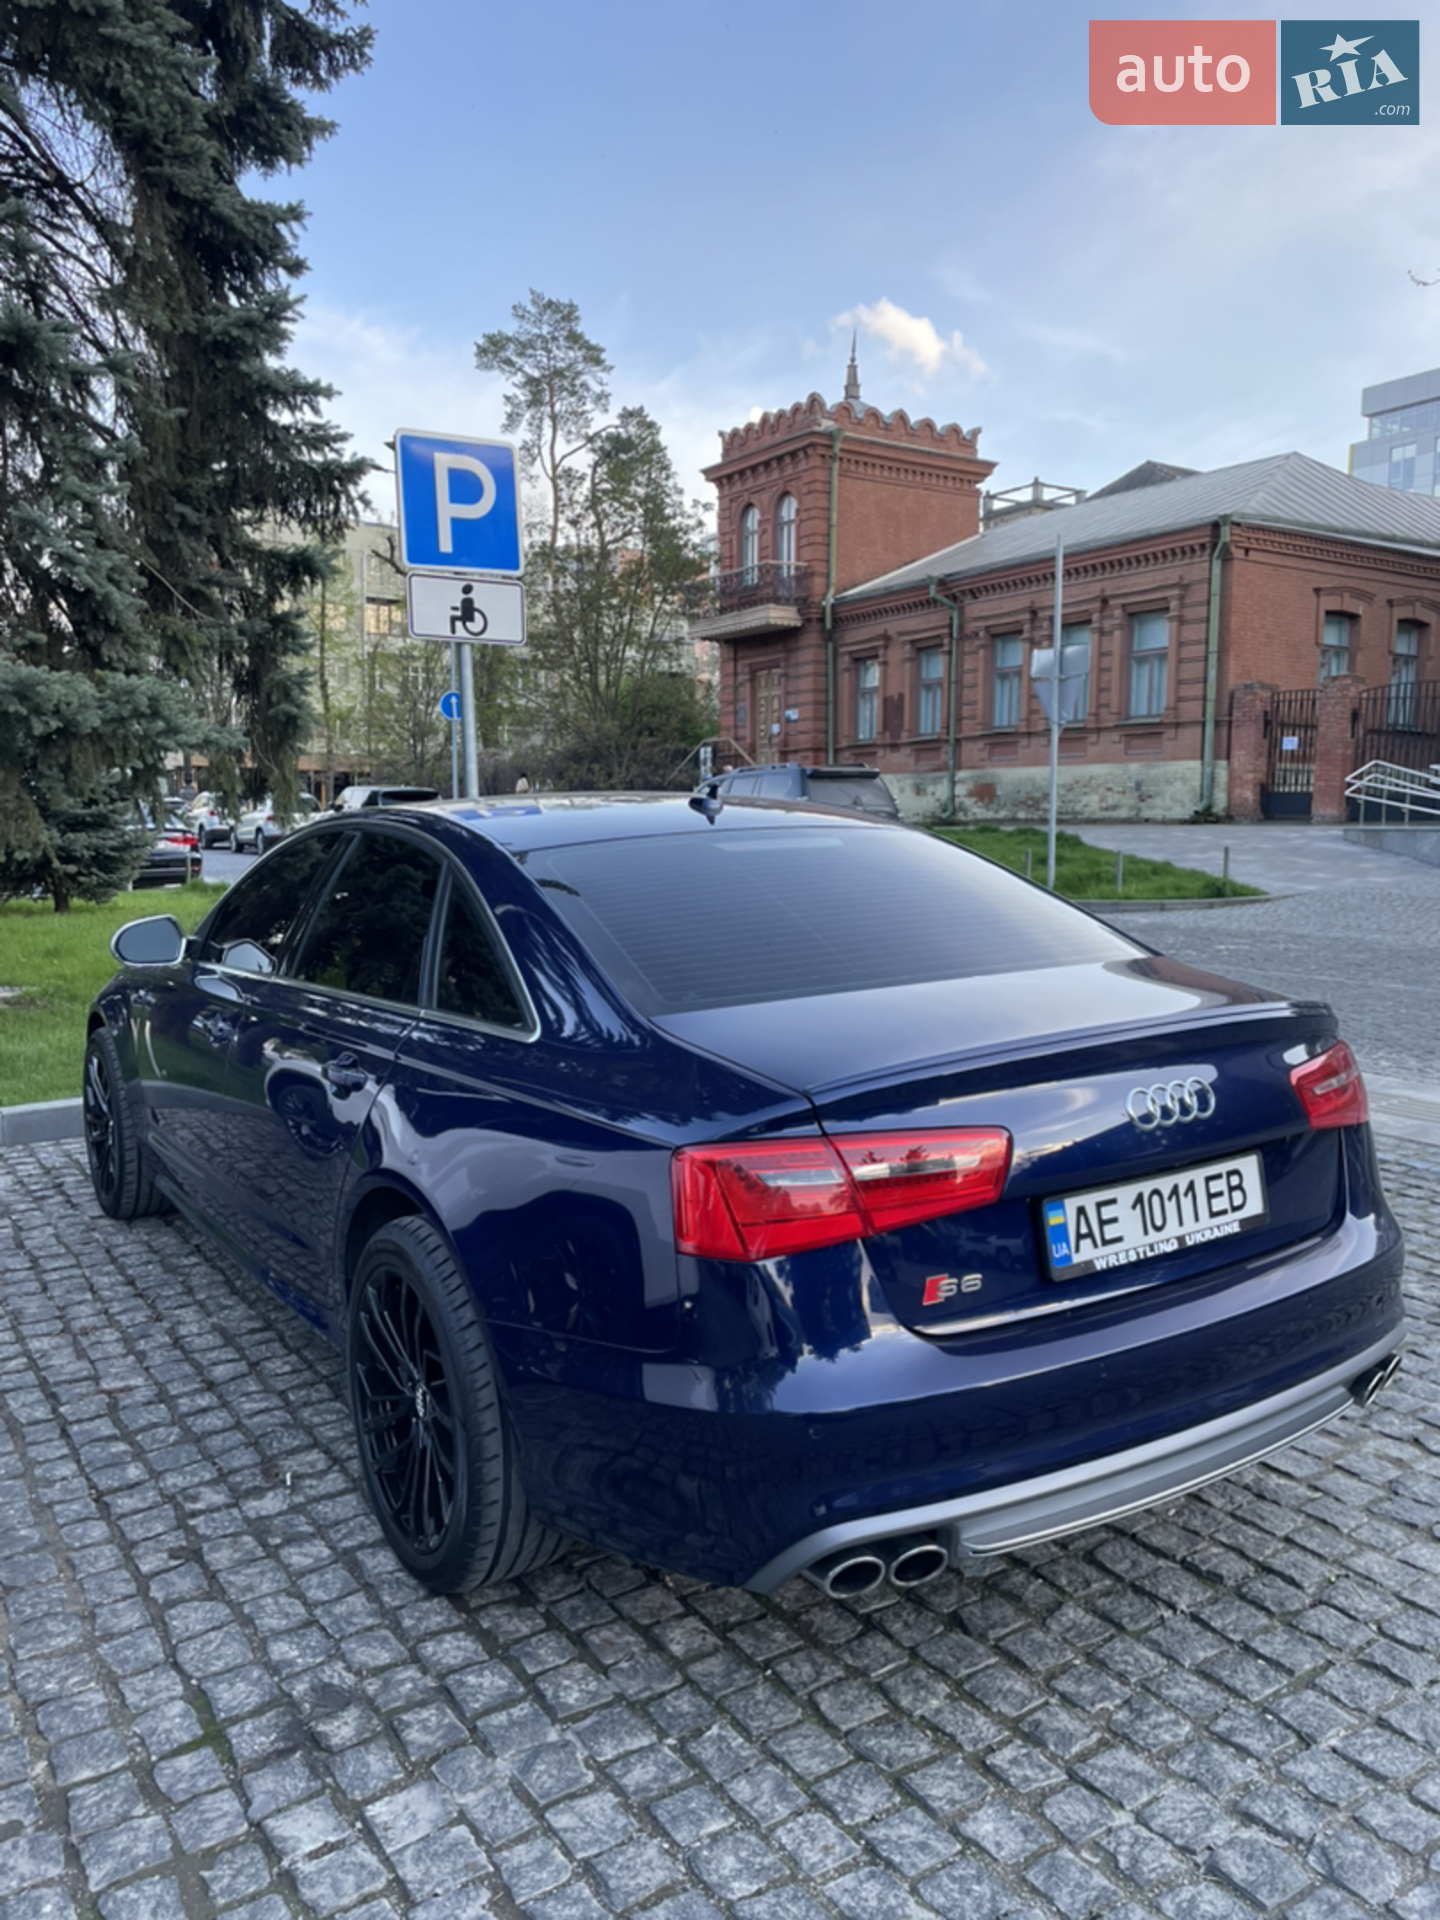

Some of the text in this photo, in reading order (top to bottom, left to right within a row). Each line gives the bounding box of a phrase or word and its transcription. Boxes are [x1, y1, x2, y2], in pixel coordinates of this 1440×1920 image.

[433, 452, 497, 554] P
[1074, 1168, 1247, 1254] AE 1011 EB
[1052, 1242, 1070, 1258] UA
[1093, 1219, 1242, 1271] WRESTLING UKRAINE
[935, 1273, 983, 1298] S6
